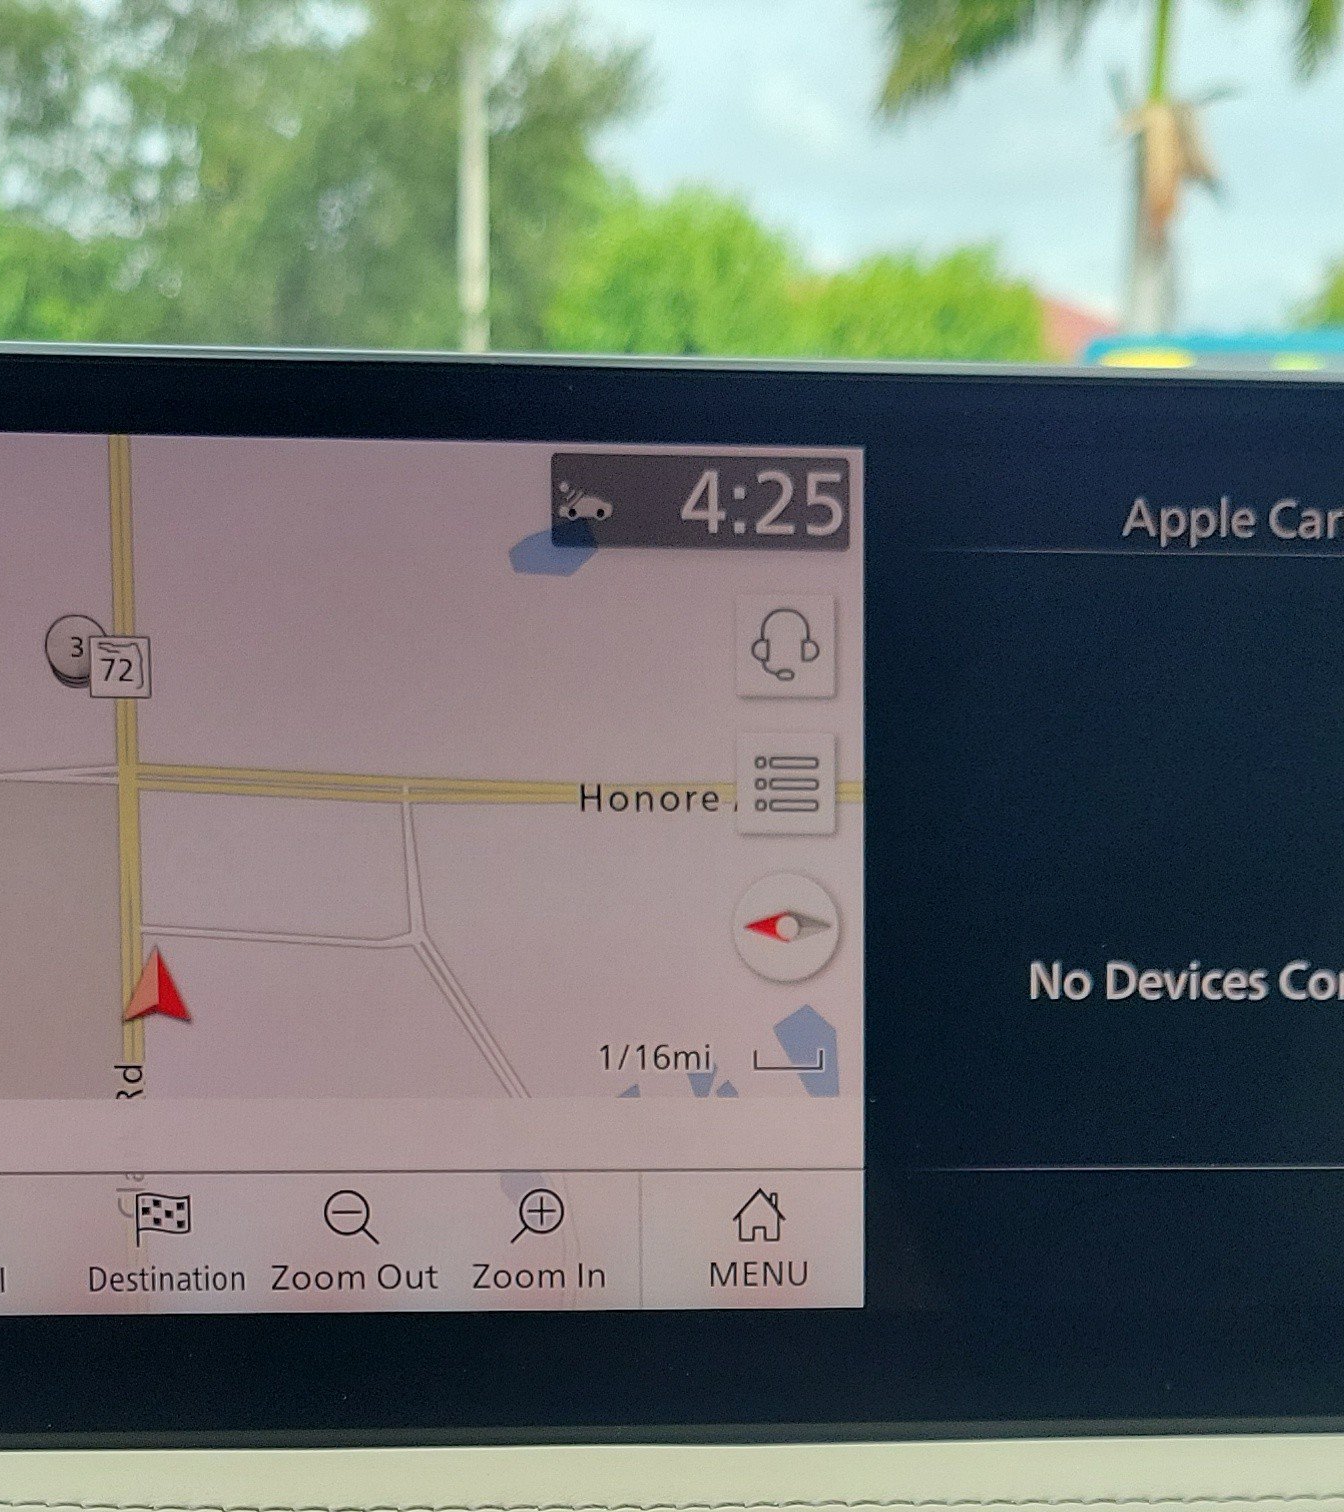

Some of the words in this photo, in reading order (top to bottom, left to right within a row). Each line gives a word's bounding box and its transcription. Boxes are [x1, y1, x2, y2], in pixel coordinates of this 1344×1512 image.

[680, 468, 844, 537] 4:25
[1121, 495, 1257, 549] Apple
[70, 635, 85, 659] 3
[99, 656, 134, 683] 72
[578, 782, 720, 813] Honore
[1028, 959, 1092, 1002] No
[1105, 959, 1269, 1002] Devices
[599, 1043, 711, 1071] 1/16mi
[87, 1264, 247, 1294] Destination
[270, 1264, 367, 1291] Zoom
[376, 1263, 440, 1291] Out
[472, 1263, 567, 1291] Zoom
[577, 1262, 607, 1290] In
[709, 1260, 809, 1288] MENU
